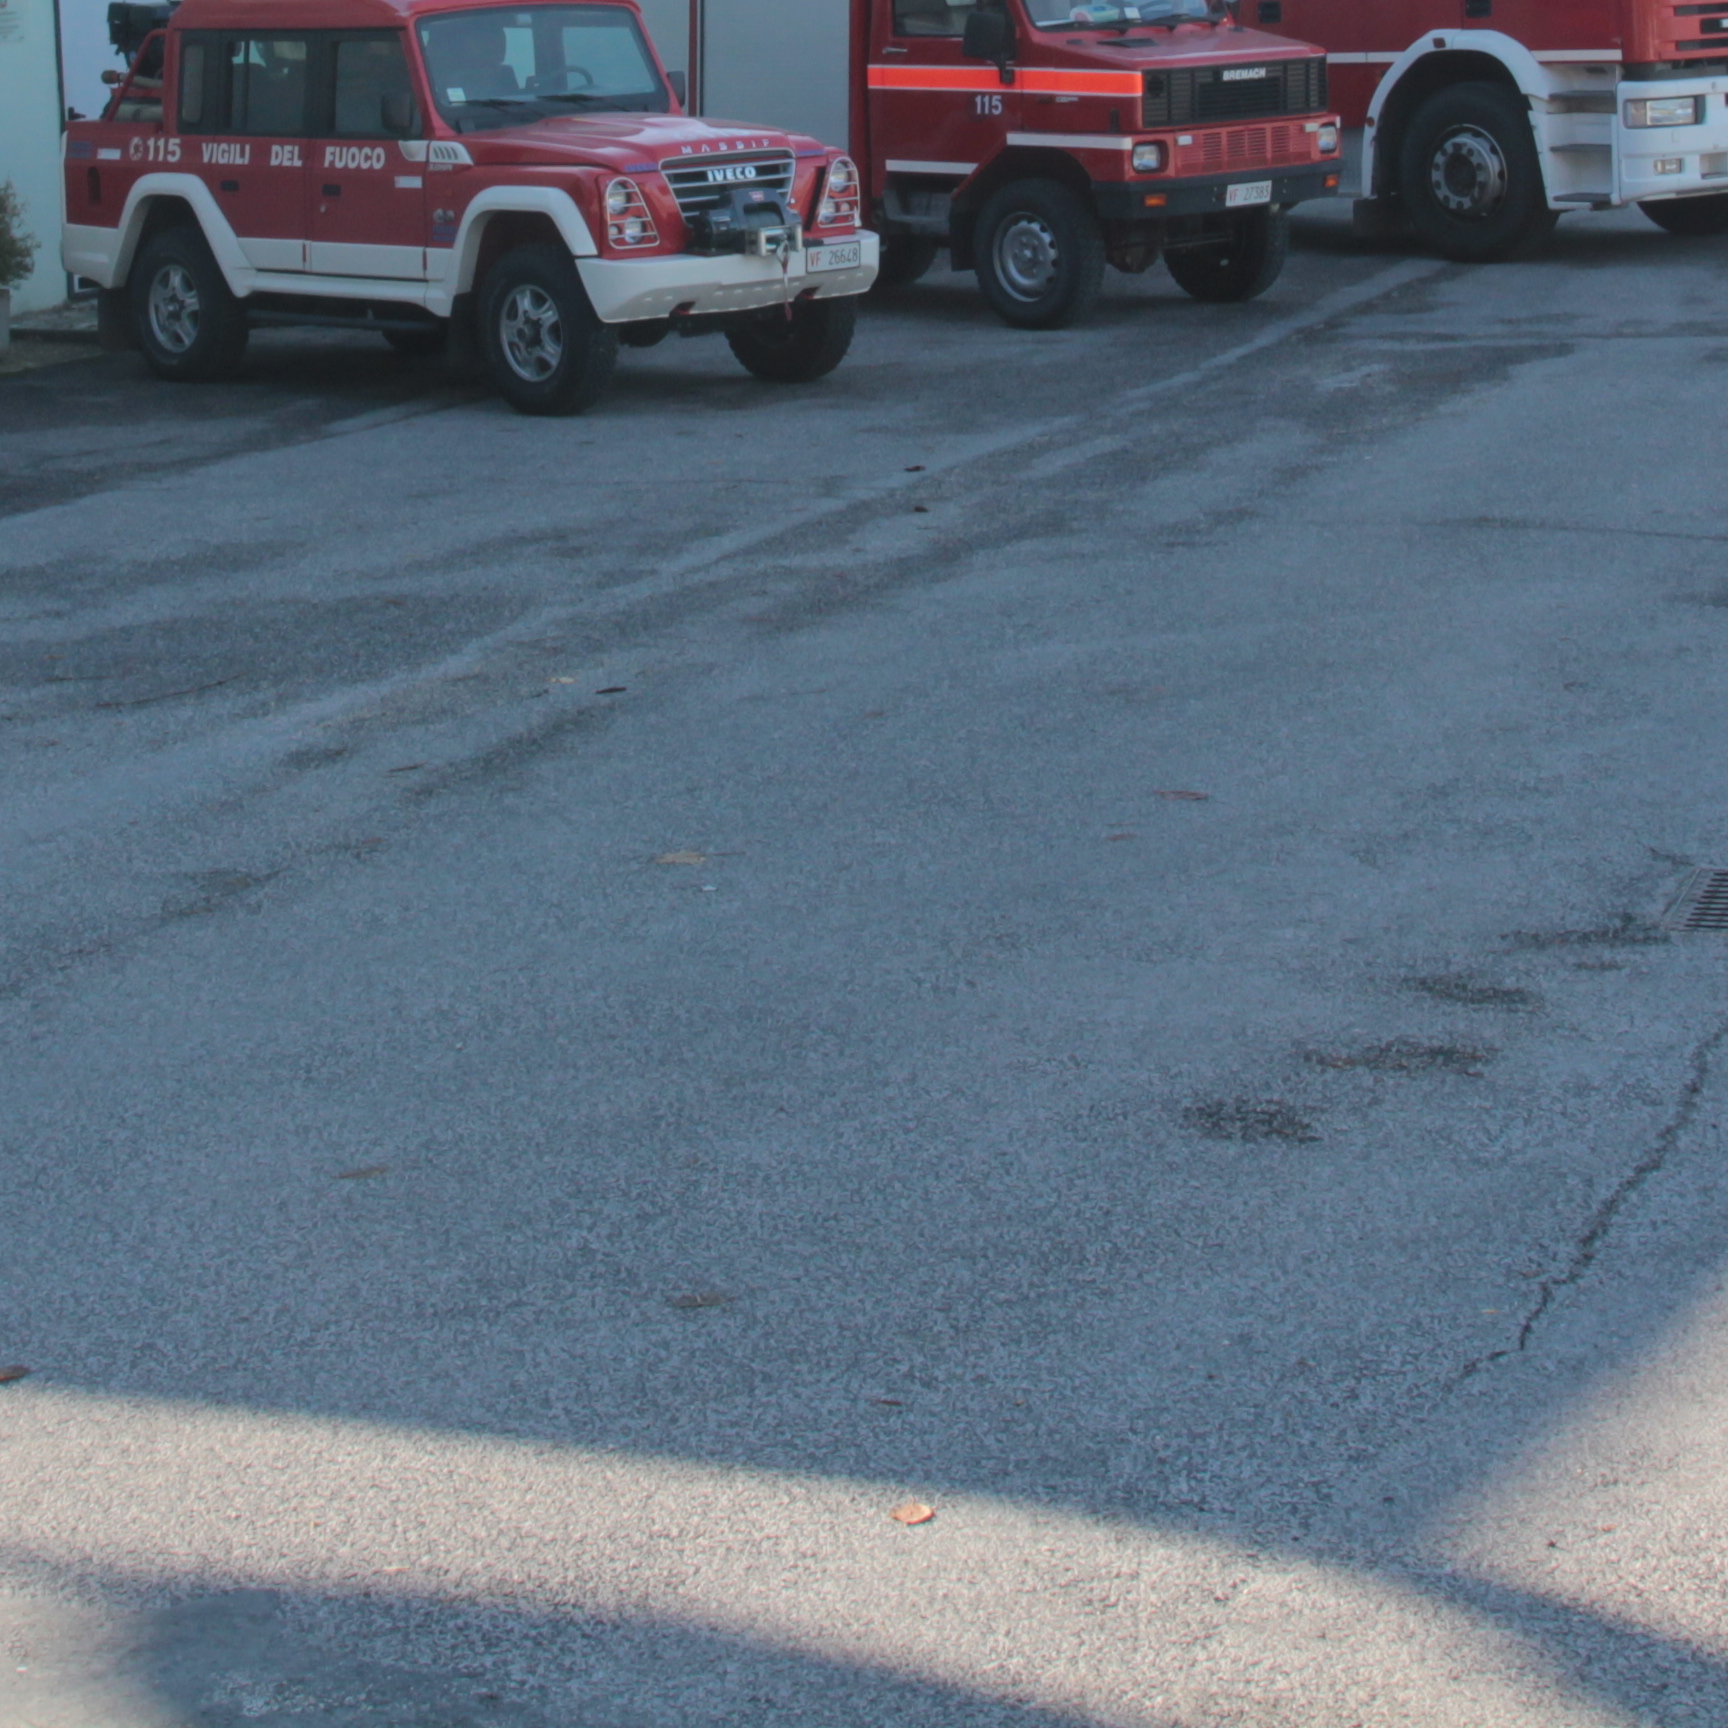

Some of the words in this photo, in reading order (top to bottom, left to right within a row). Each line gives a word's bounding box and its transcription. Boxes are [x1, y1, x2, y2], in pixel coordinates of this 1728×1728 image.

[1223, 67, 1266, 81] BREMACH
[975, 95, 1003, 115] 115
[146, 138, 181, 163] 115
[202, 142, 251, 166] VIGILI
[270, 144, 303, 167] DEL
[324, 145, 386, 170] FUOCO
[707, 166, 757, 182] IVECO
[1229, 189, 1238, 202] VF
[810, 251, 822, 267] VF
[828, 247, 858, 265] 26648
